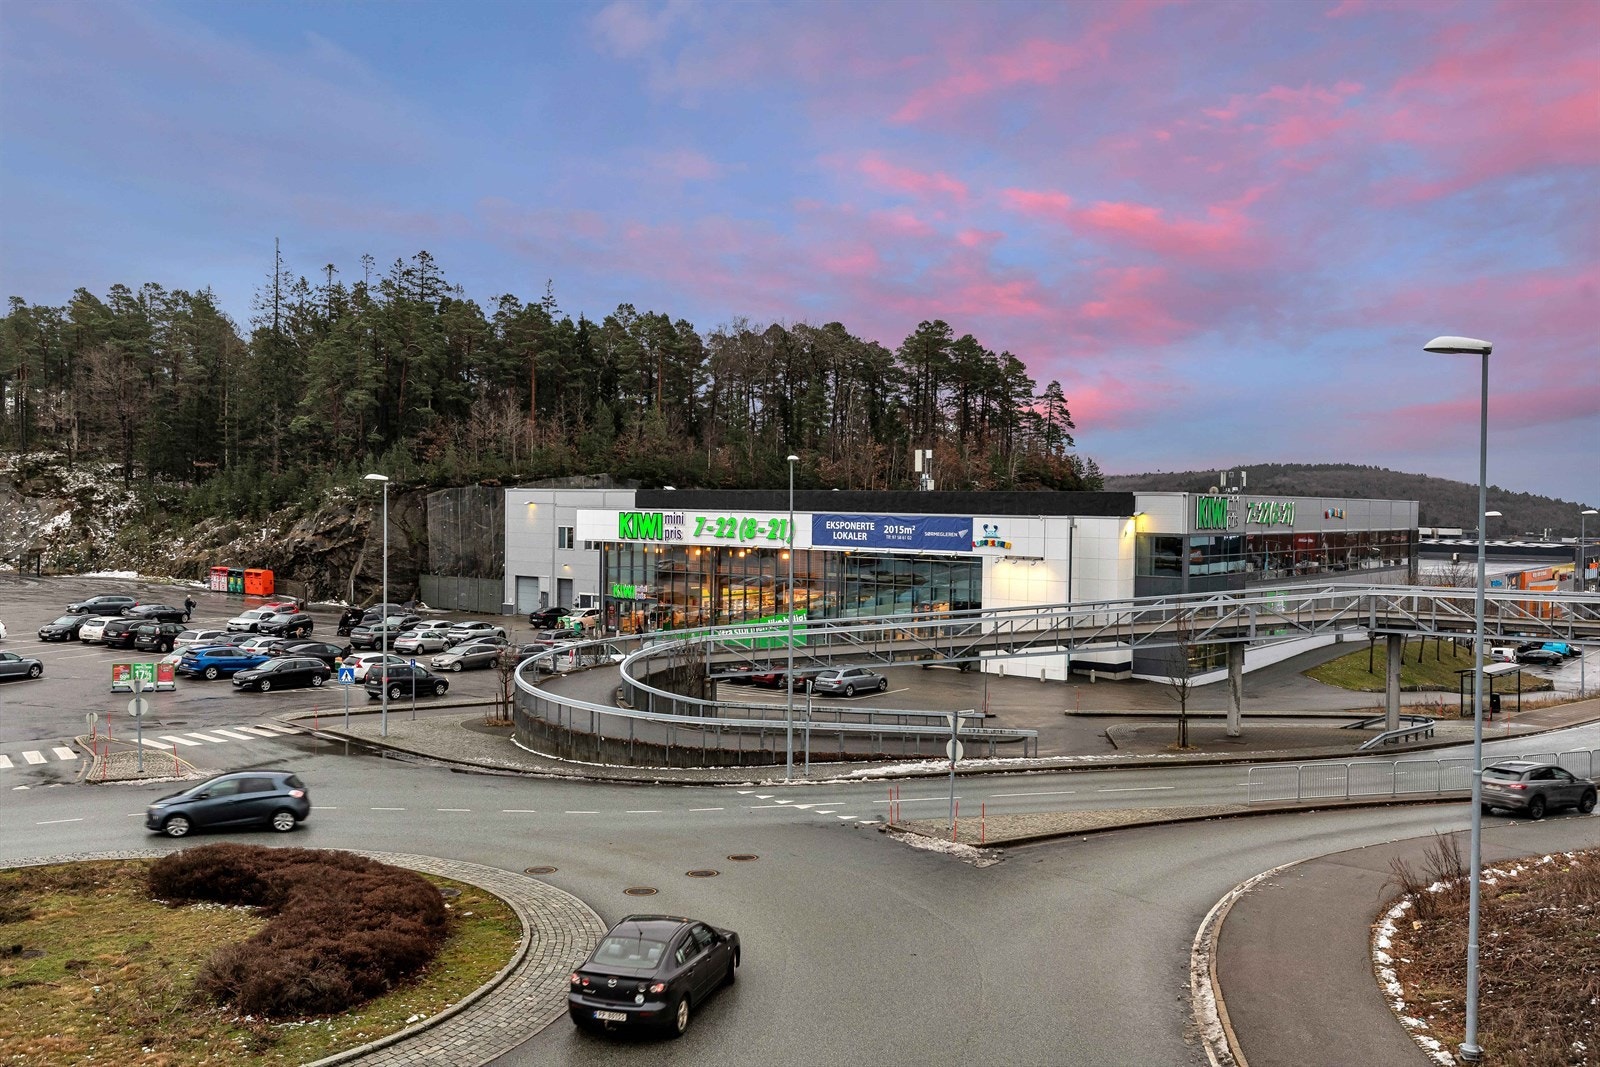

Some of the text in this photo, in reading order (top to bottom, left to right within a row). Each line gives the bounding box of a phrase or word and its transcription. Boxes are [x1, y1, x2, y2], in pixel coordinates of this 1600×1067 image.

[665, 512, 684, 524] mini
[1196, 496, 1229, 530] KIWI
[619, 512, 663, 540] KIWI
[826, 521, 875, 531] EKSPONERTE
[664, 528, 682, 541] pris
[833, 531, 868, 541] LOKALER
[612, 584, 635, 599] KIWI
